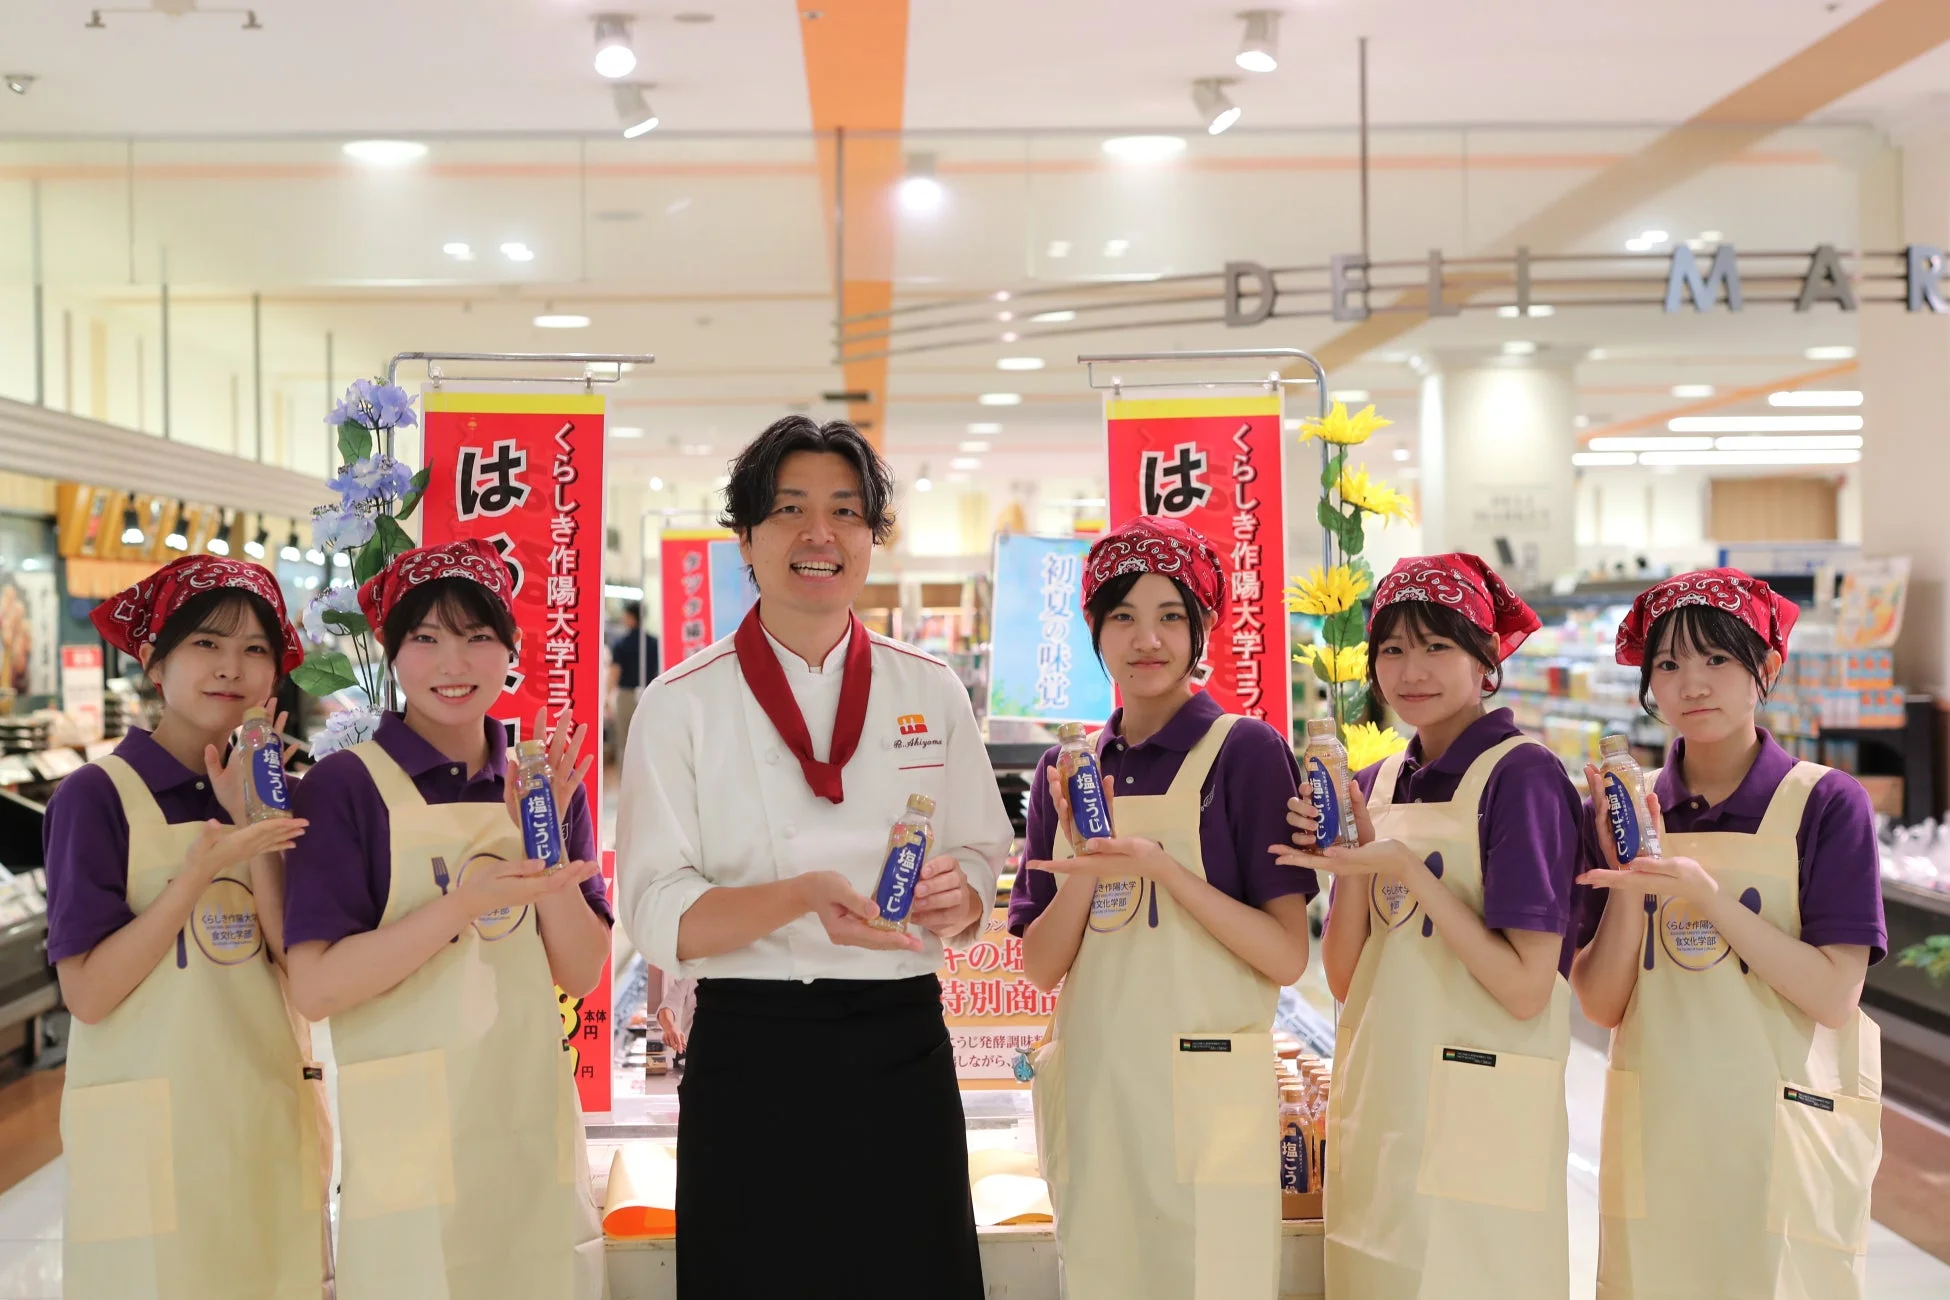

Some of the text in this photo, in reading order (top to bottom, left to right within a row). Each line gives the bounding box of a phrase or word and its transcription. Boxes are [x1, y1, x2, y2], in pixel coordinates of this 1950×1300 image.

[1225, 243, 1950, 327] DELI MAR
[1036, 552, 1078, 709] 初夏の味覚
[263, 748, 286, 803] 塩こうじ
[1076, 773, 1103, 833] 塩こうじ
[528, 796, 551, 860] 塩こうじ
[887, 846, 917, 913] 塩こうじ
[584, 1009, 607, 1024] 本体
[584, 1025, 598, 1040] 円
[581, 1066, 594, 1078] 円
[953, 1054, 1012, 1068] しながら、
